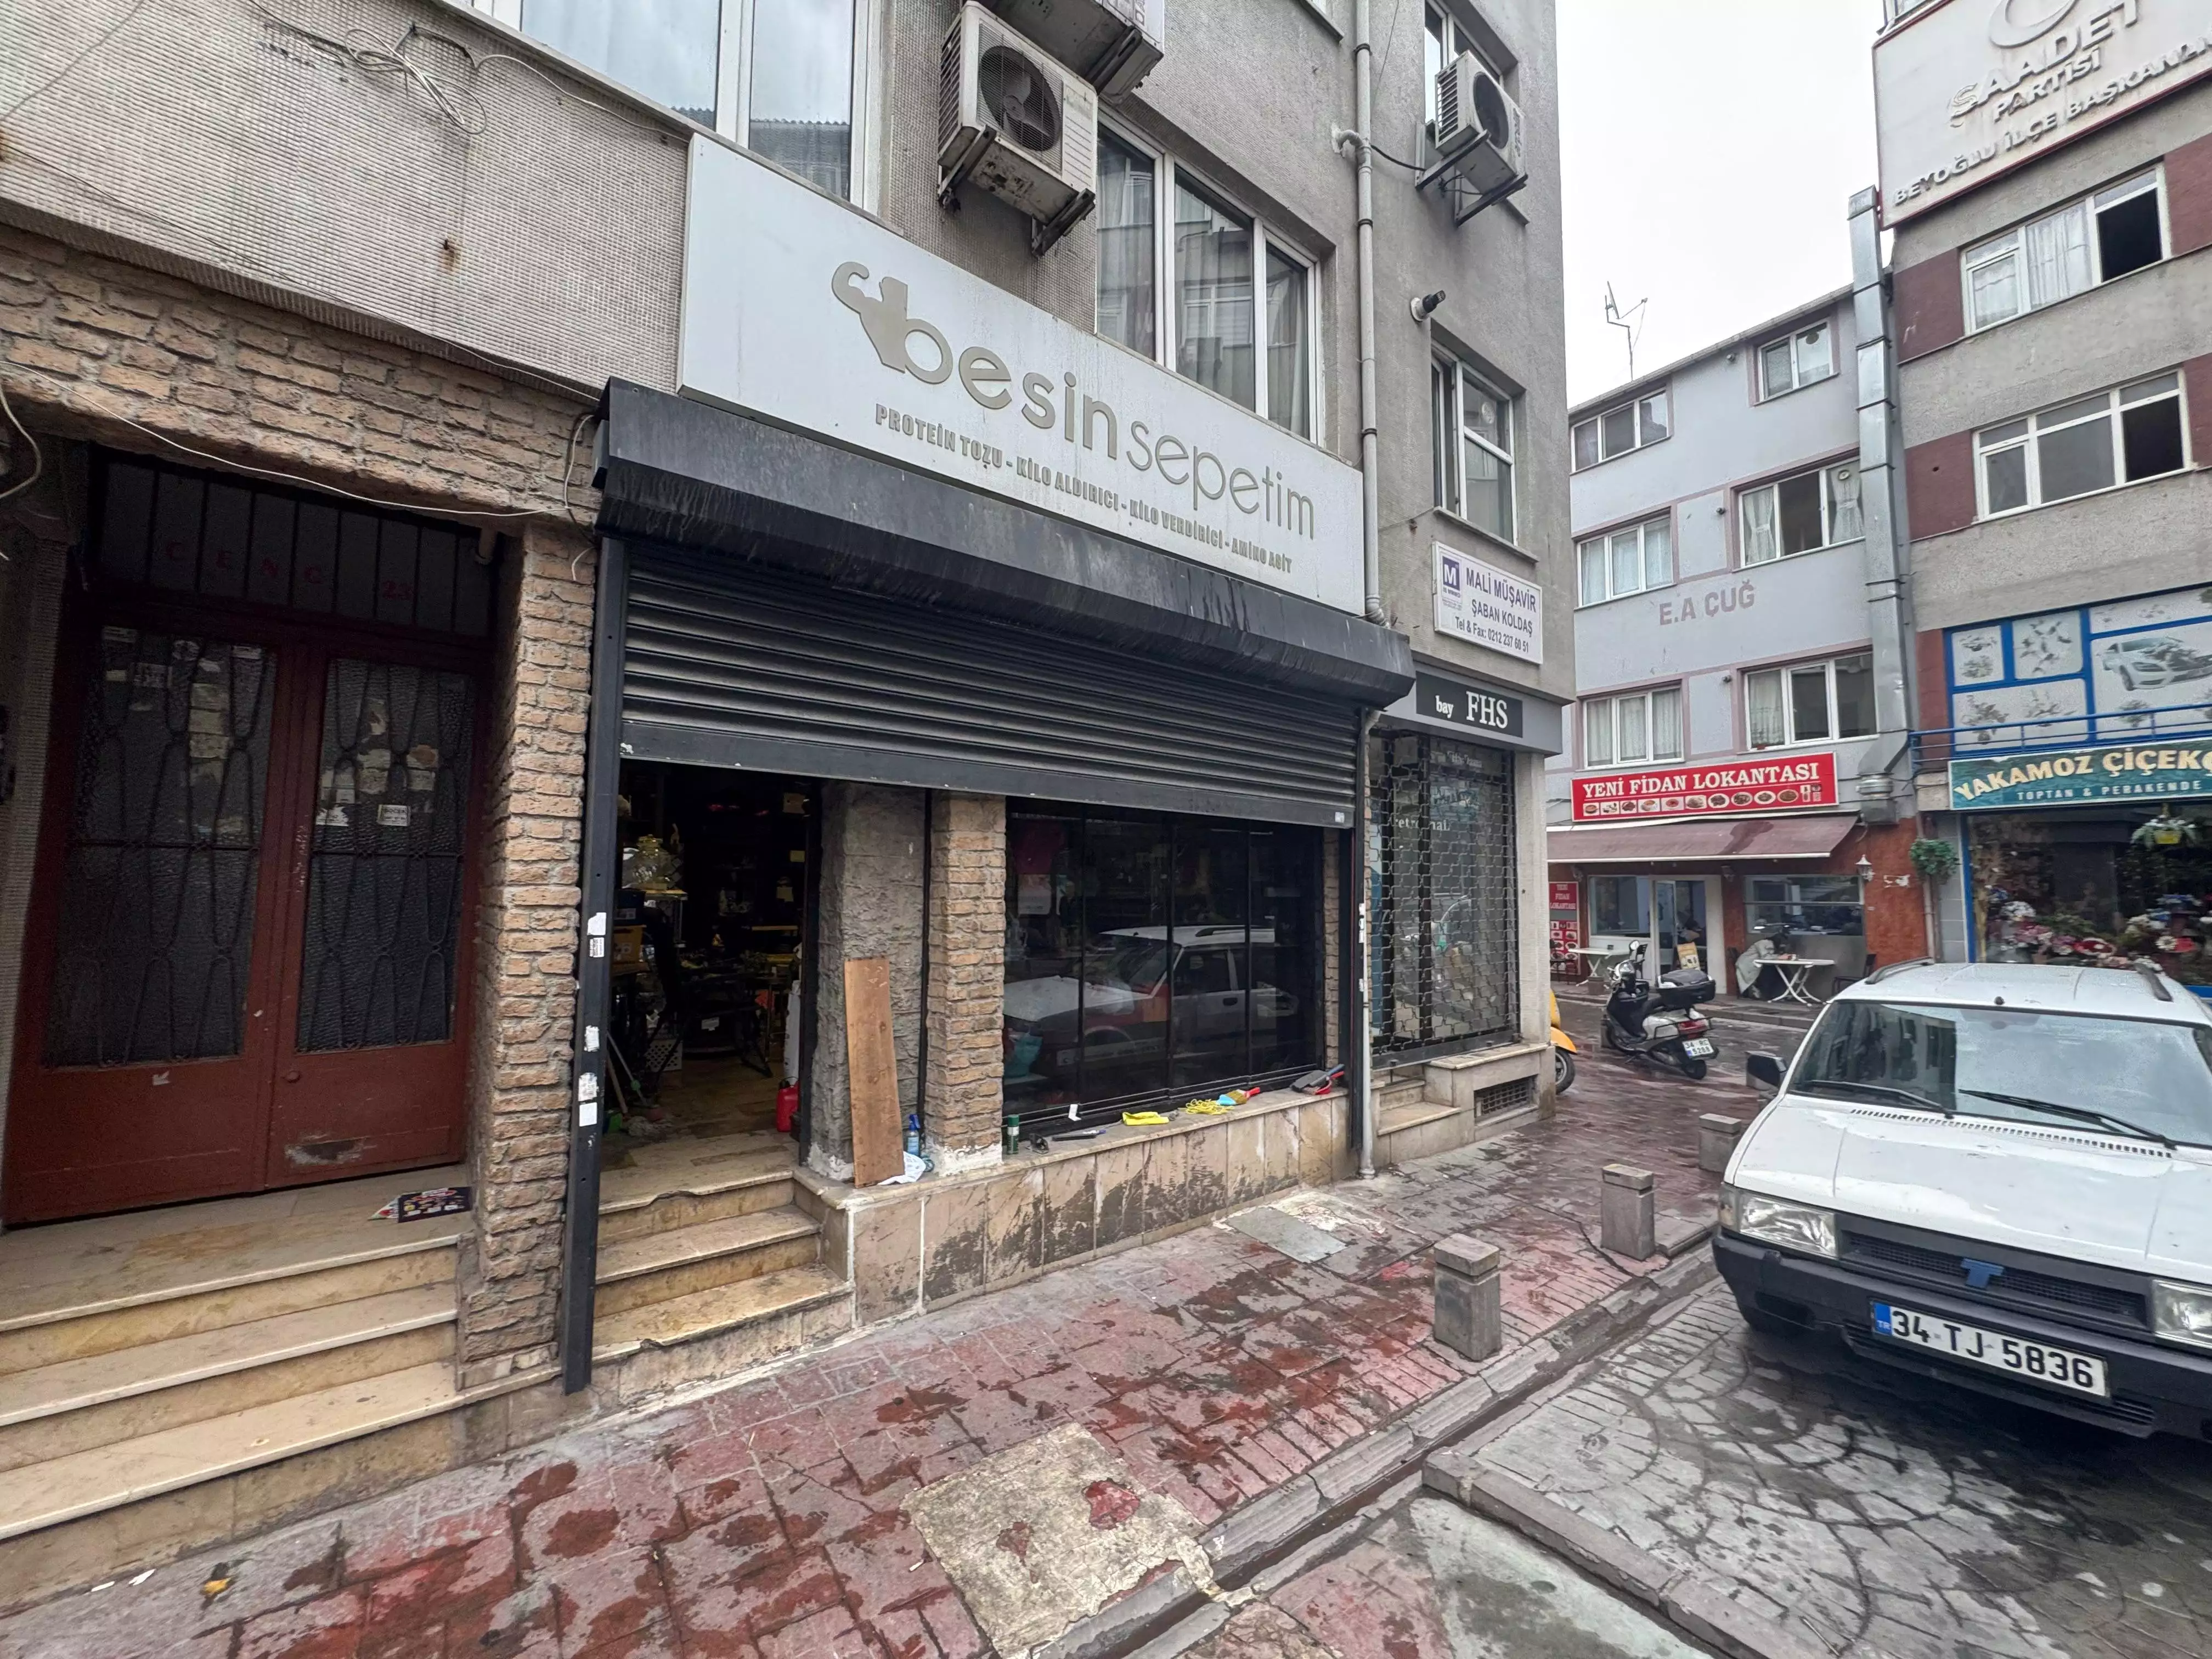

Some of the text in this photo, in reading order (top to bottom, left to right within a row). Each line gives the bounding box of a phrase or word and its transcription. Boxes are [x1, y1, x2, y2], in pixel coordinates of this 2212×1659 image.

[1994, 45, 2102, 123] PARTİSİ
[1894, 140, 1998, 207] BEYOĞLU
[2066, 23, 2212, 122] BAŞKANLI
[876, 403, 956, 452] PROTEİN
[960, 435, 1003, 469] TOZU
[1017, 455, 1052, 487] KİLO
[1054, 471, 1119, 511] ALDIRICI
[1130, 499, 1159, 525] KİLO
[1161, 510, 1223, 549] VERDİRİCİ
[1231, 538, 1267, 565] AMİNO
[1268, 550, 1293, 574] ASİT
[1466, 567, 1492, 595] MALİ
[1494, 579, 1537, 613] MÜŞAVİR
[1455, 616, 1465, 631] Tel
[1473, 623, 1487, 639] Fax:
[1488, 628, 1502, 644] 0212
[1503, 633, 1514, 647] 237
[1515, 637, 1521, 651] 60
[1522, 640, 1529, 653] 51
[1471, 599, 1500, 623] ŞABAN
[1502, 610, 1533, 638] KOLDAŞ
[1435, 691, 1508, 729] bay FHS
[1582, 763, 1820, 799] YENİ FİDAN LOKANTASI
[1953, 755, 2094, 800] YAKAMOZ
[2017, 789, 2074, 800] TOPTAN
[2102, 780, 2203, 795] PERAKENDE
[1876, 1310, 2094, 1389] TR 34 TJ 5836
